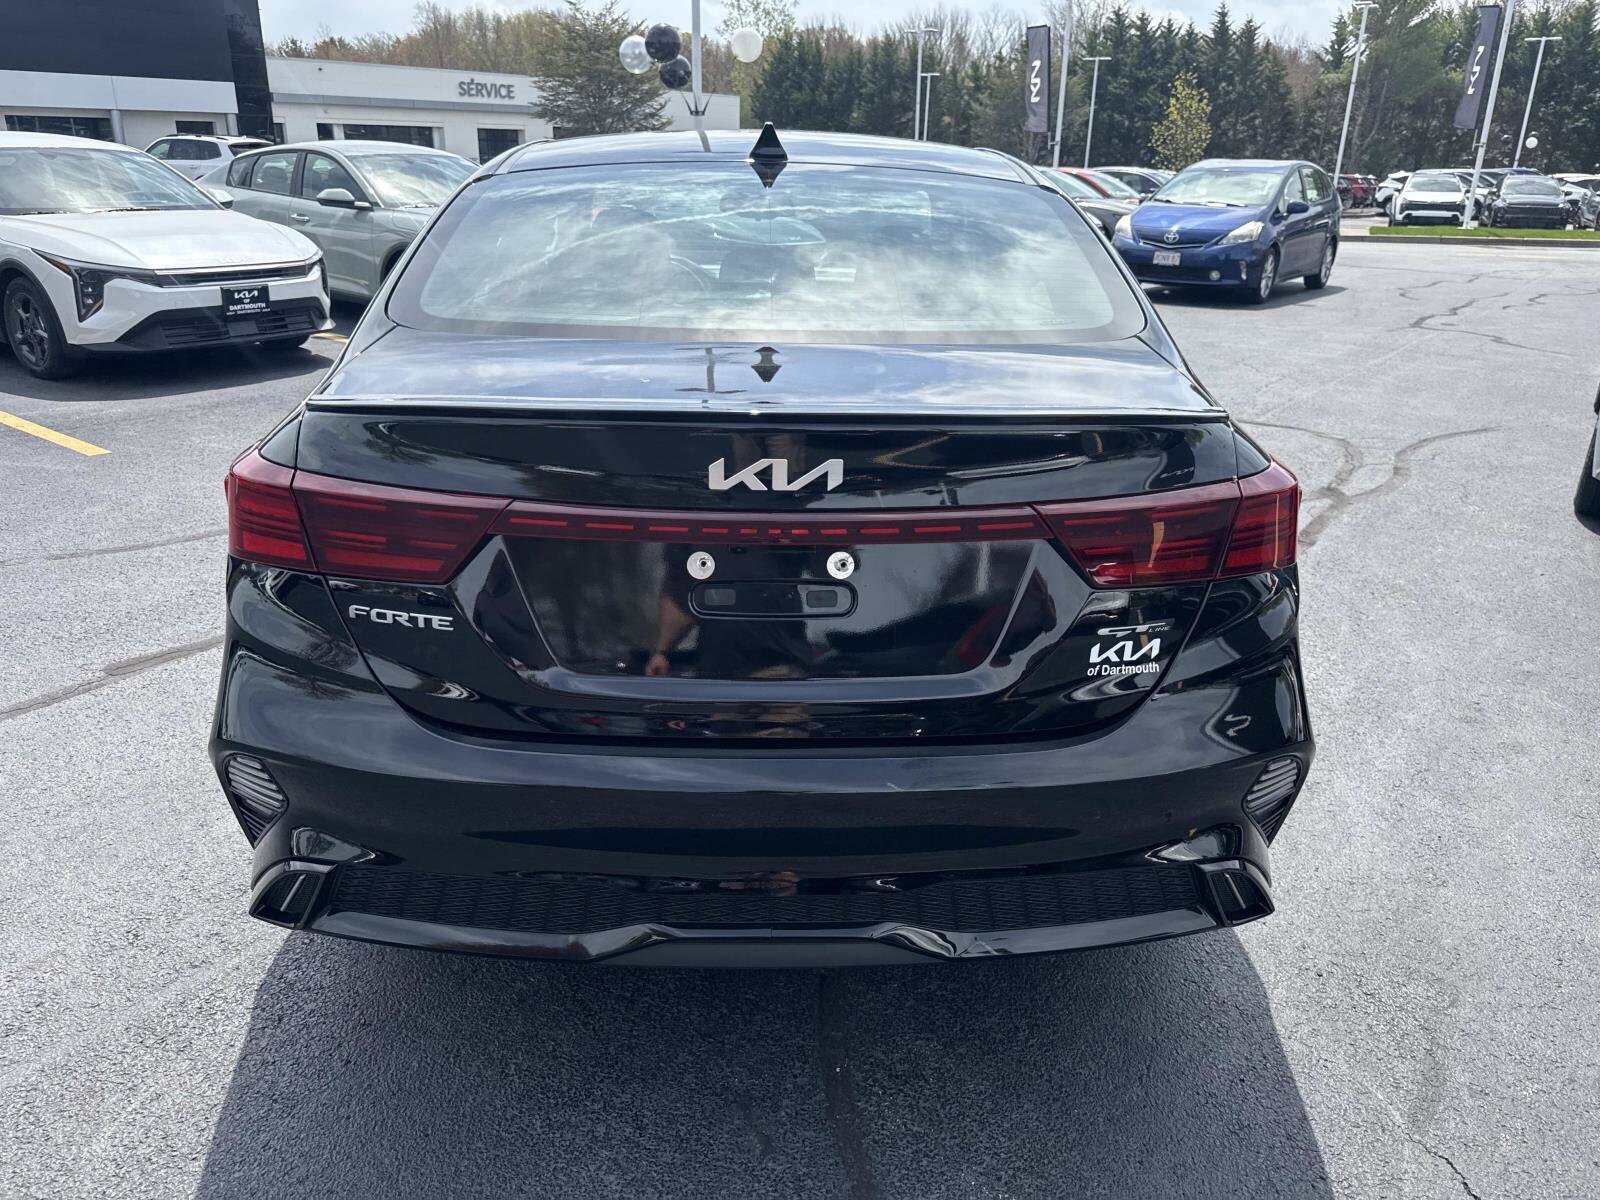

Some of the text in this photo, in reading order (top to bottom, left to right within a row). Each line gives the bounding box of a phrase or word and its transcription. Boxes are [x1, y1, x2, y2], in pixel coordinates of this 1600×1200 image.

[235, 290, 258, 299] KIA
[229, 302, 266, 311] DARTMOUTH
[708, 457, 844, 492] KIA
[348, 604, 454, 631] FORTE
[1097, 622, 1166, 638] GT
[1089, 638, 1161, 663] KIA
[1087, 661, 1160, 676] of Dartmouth
